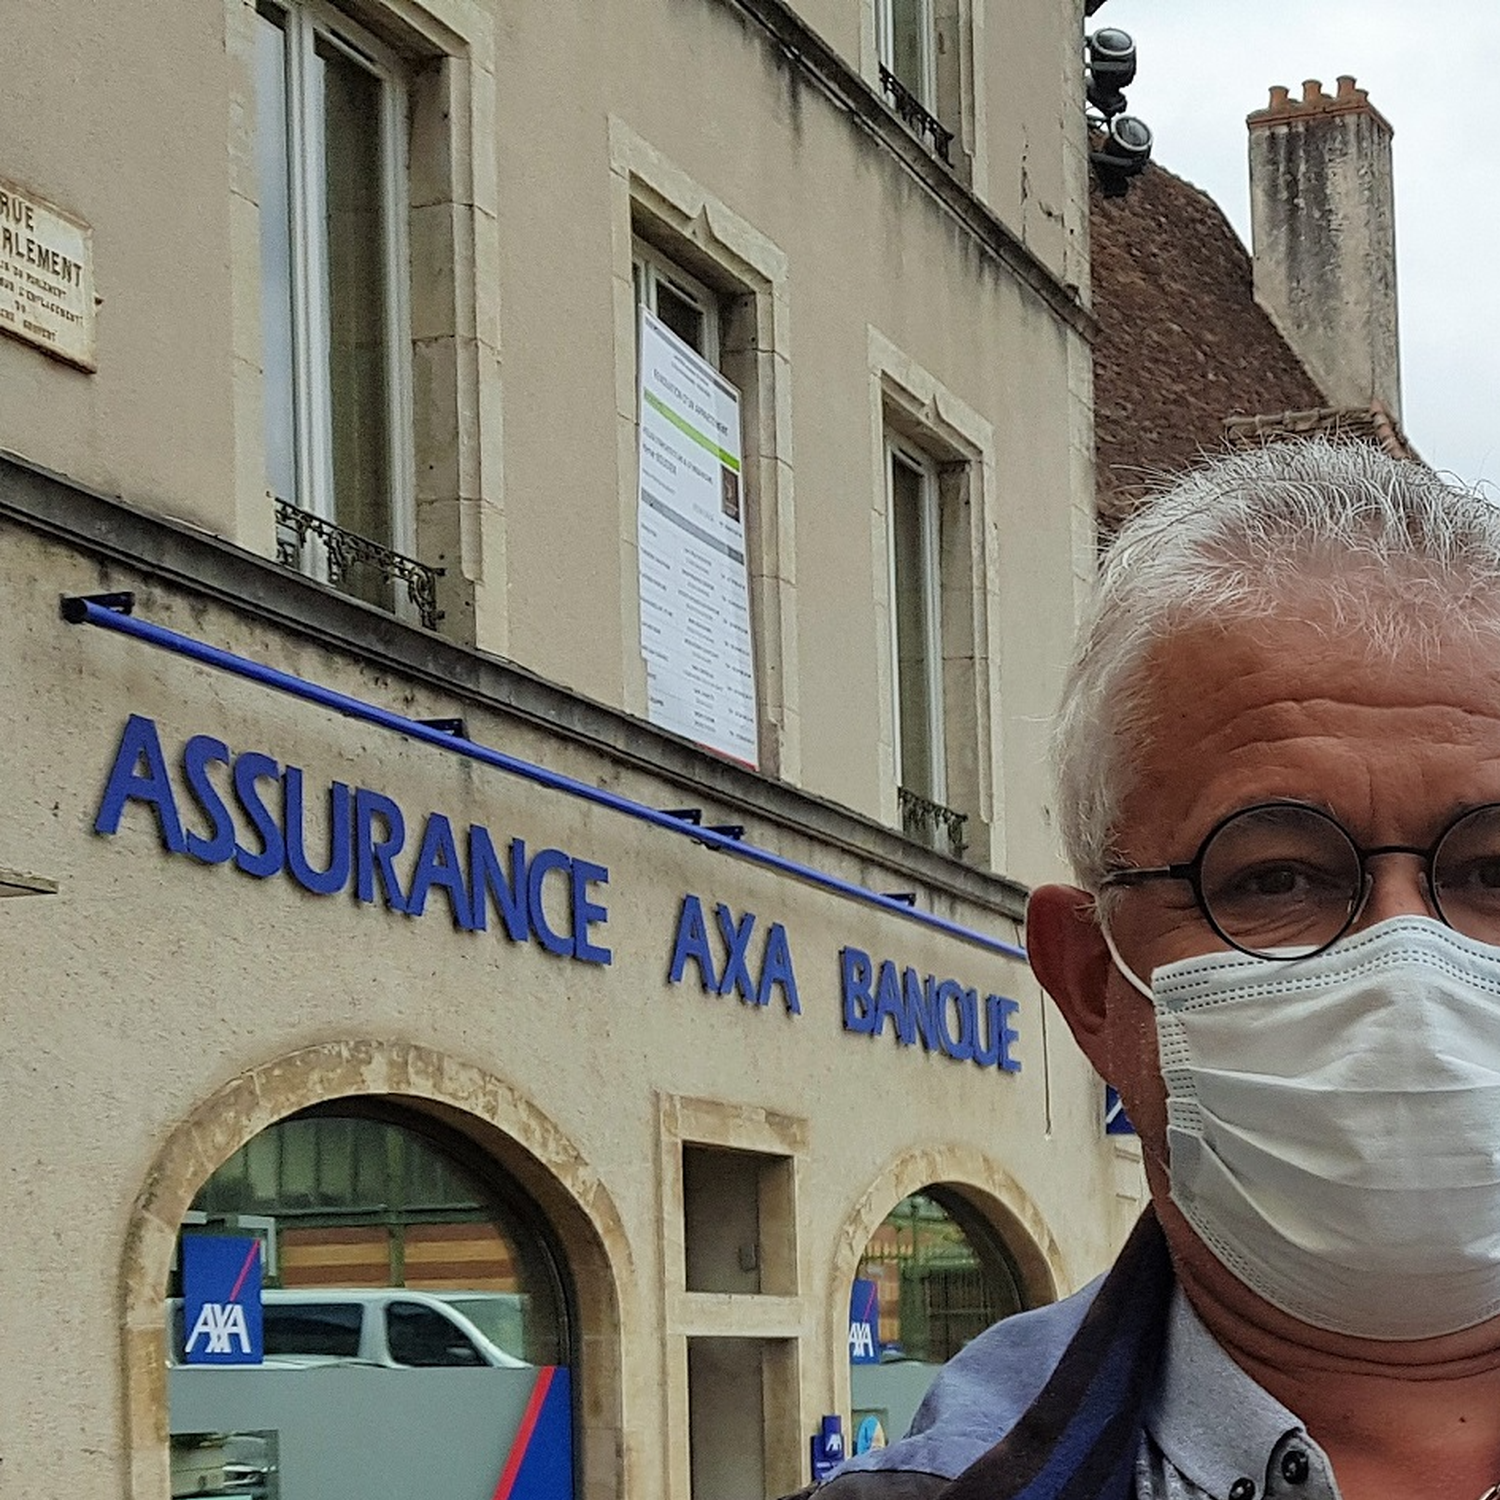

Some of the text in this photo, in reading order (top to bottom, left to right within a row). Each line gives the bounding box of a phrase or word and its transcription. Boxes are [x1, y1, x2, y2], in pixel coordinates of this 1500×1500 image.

[0, 191, 34, 233] RUE
[95, 713, 611, 966] ASSURANCE
[669, 893, 1021, 1073] AXA BANQUE
[185, 1303, 252, 1353] AXA
[849, 1322, 874, 1357] AXA
